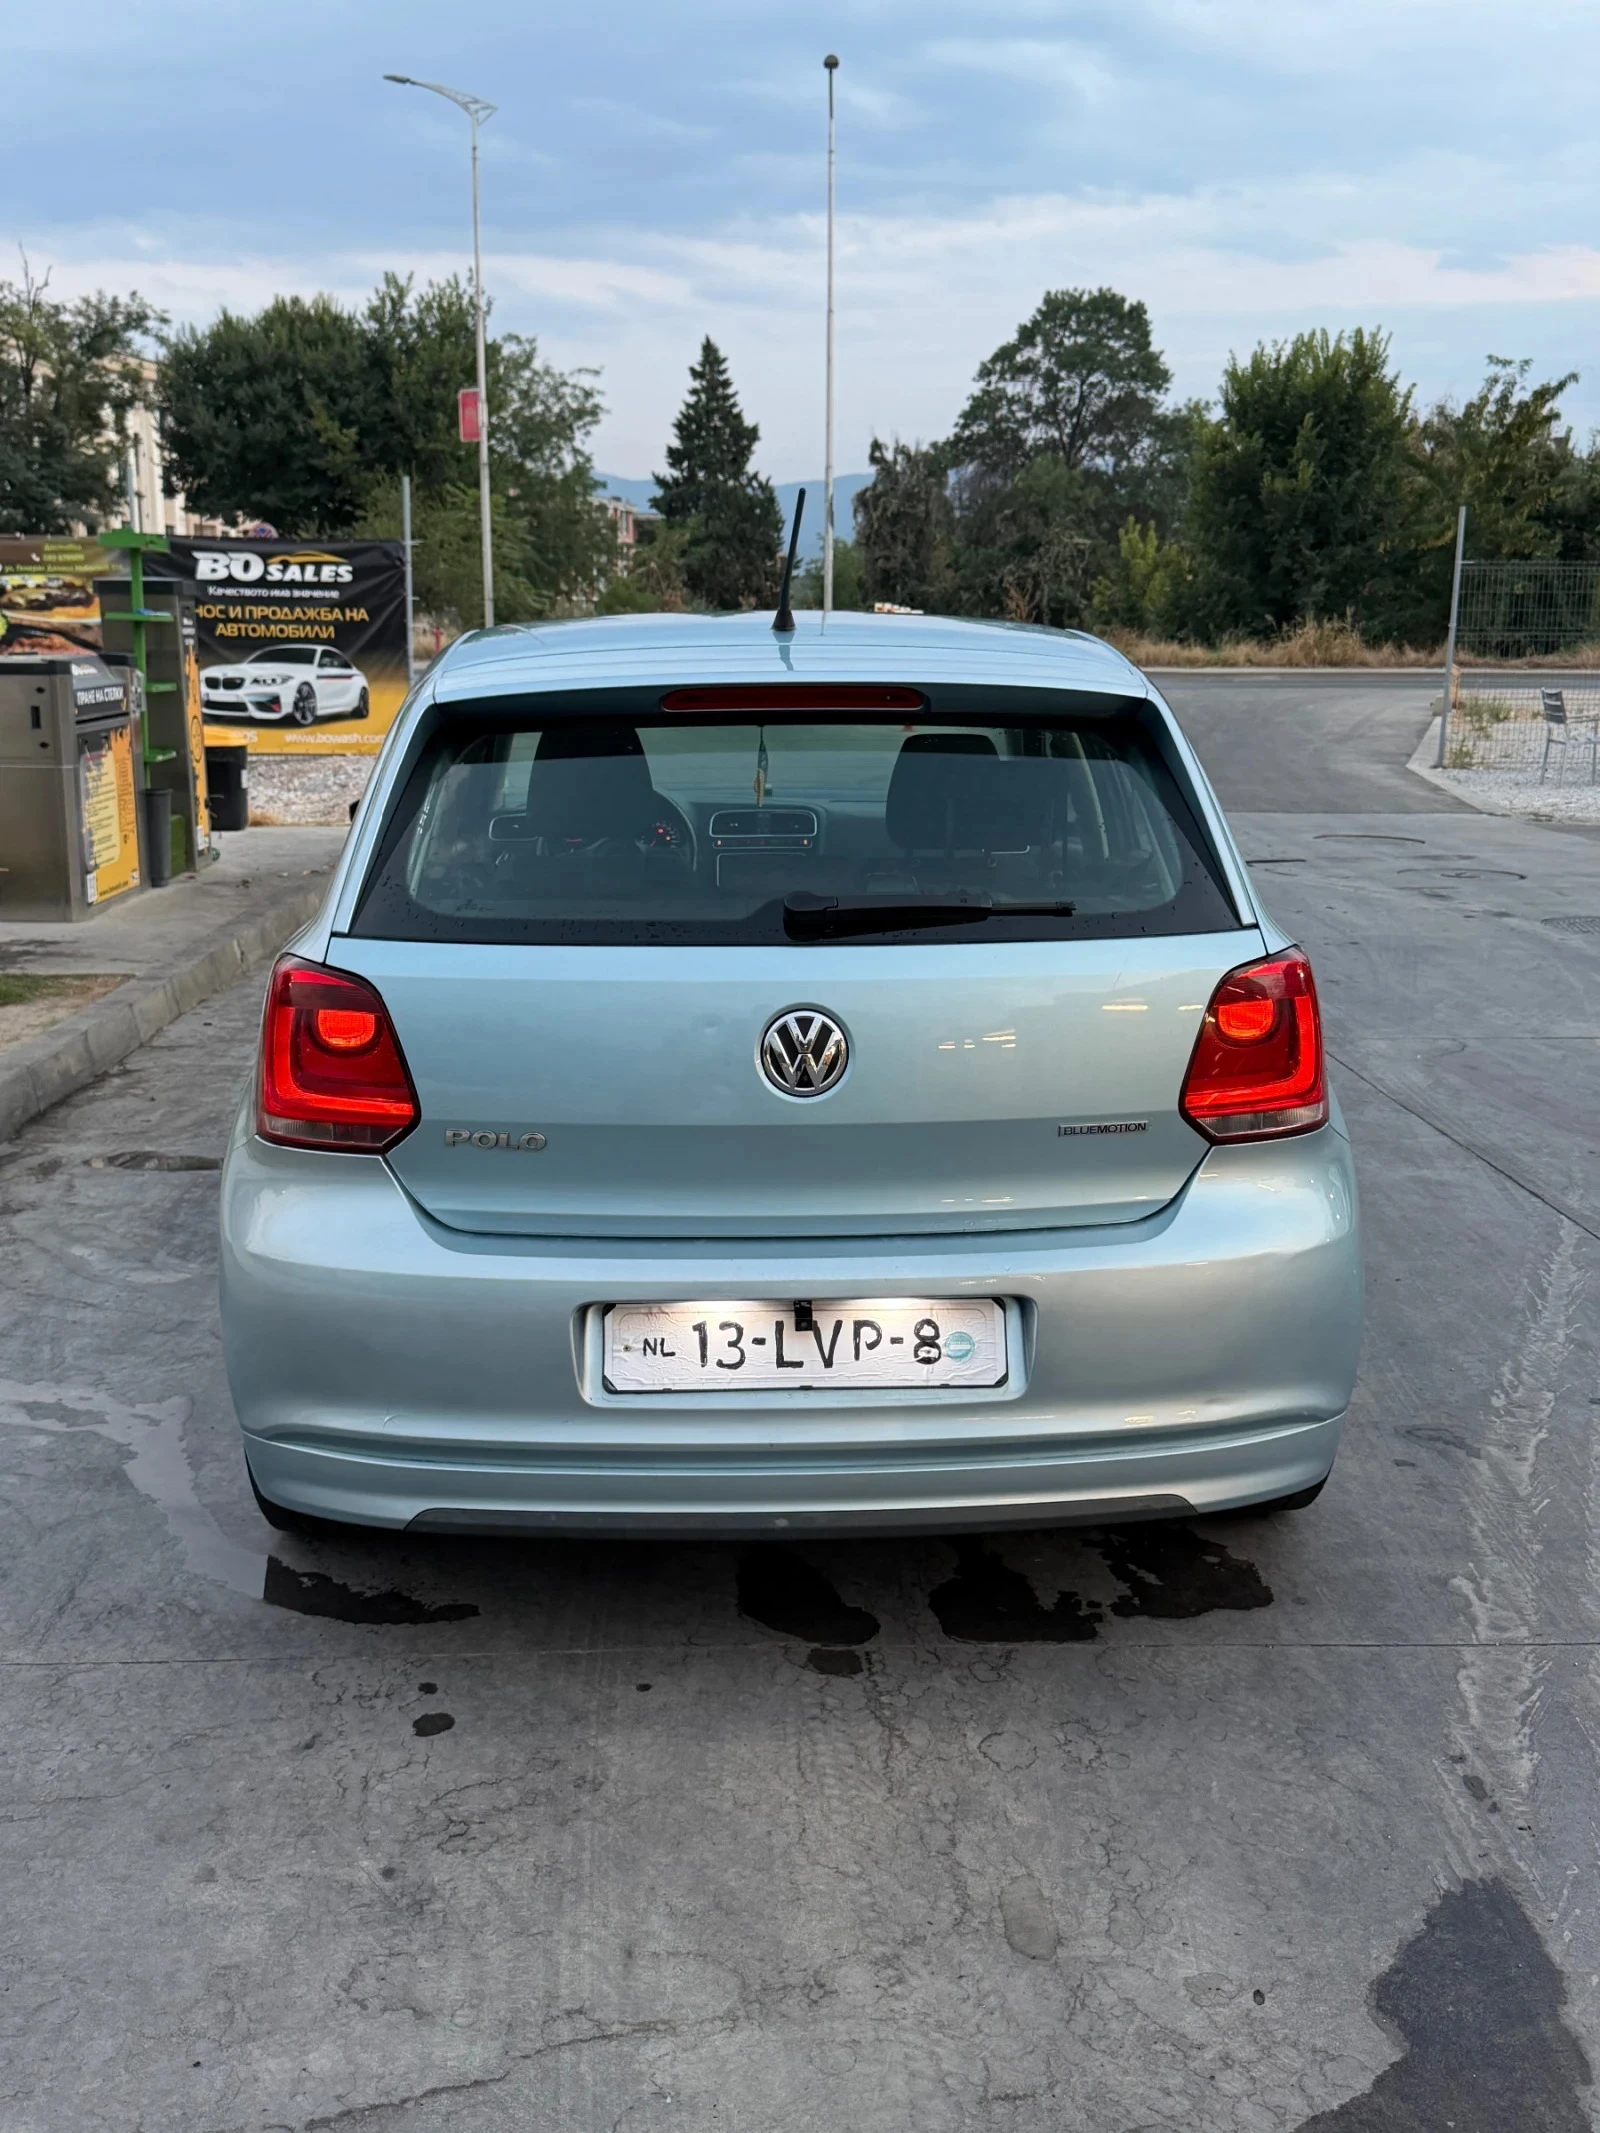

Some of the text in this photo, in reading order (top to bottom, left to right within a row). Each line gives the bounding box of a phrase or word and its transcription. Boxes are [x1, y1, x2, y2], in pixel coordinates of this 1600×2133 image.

[191, 551, 353, 583] BO SALES
[207, 586, 340, 600] Качеството има значение
[229, 605, 242, 619] И
[245, 605, 343, 621] ПРОДАЖБА
[346, 608, 369, 622] НА
[215, 623, 335, 639] АВТОМОБИЛИ
[1063, 1122, 1147, 1136] BLUEMOTION
[444, 1128, 547, 1152] POLO
[642, 1337, 676, 1358] NL
